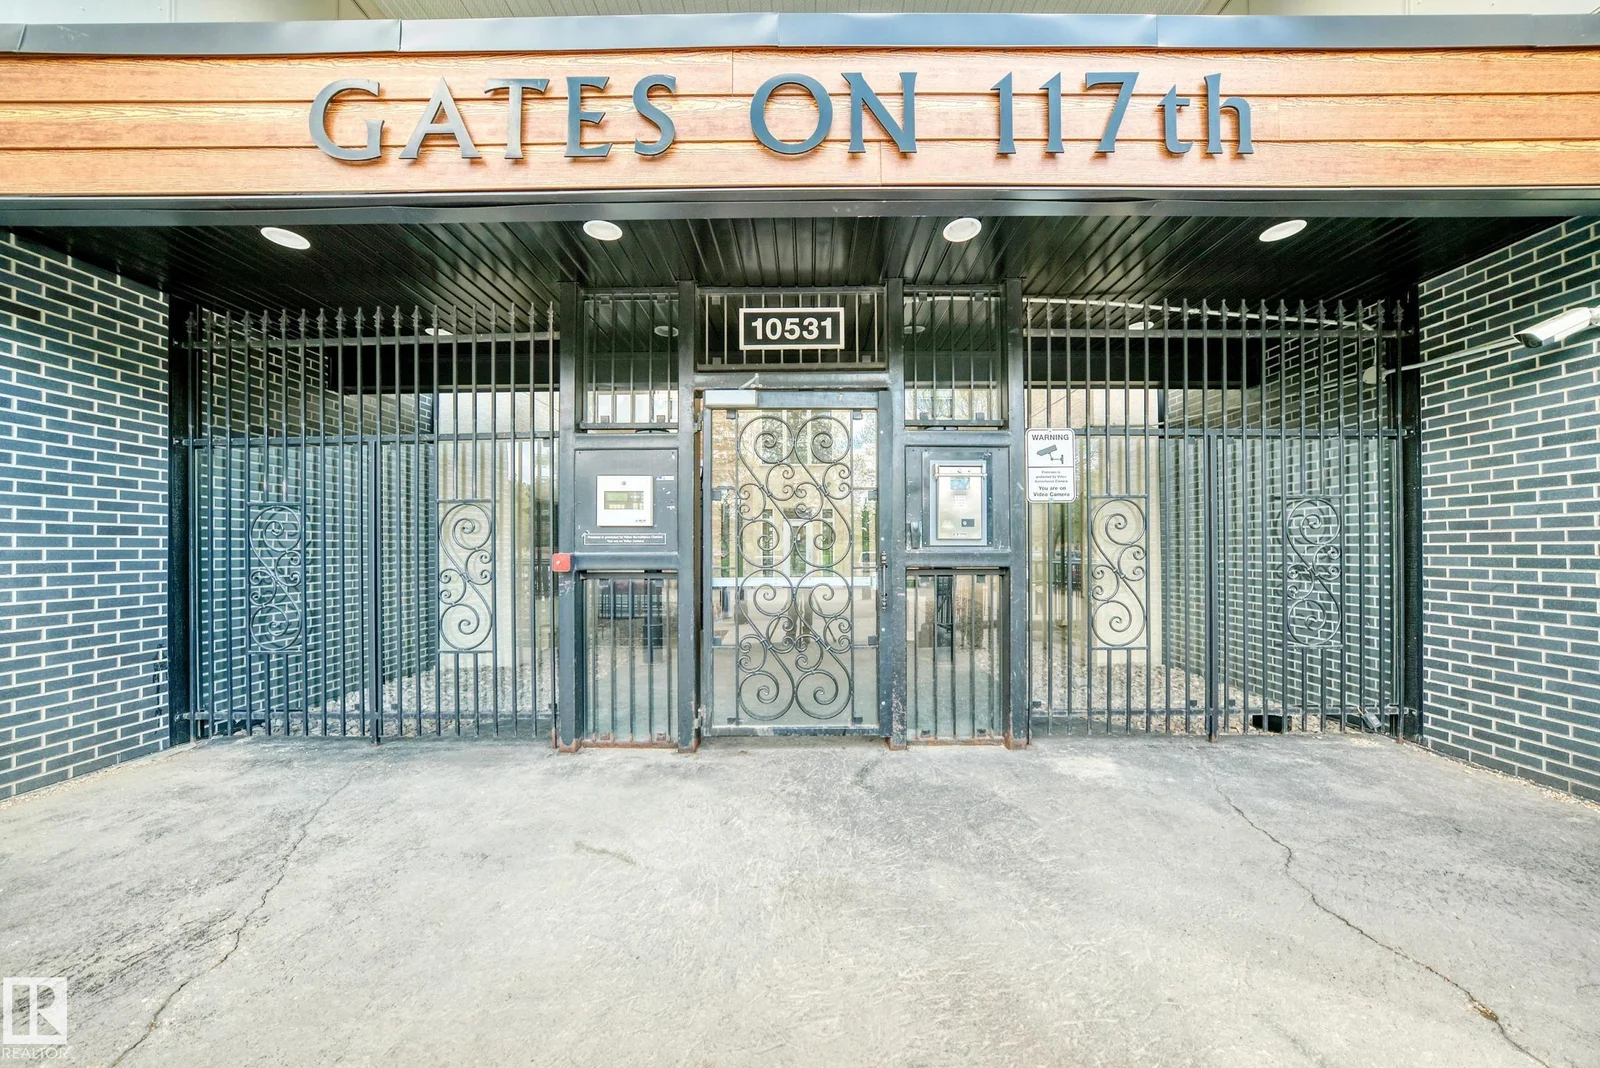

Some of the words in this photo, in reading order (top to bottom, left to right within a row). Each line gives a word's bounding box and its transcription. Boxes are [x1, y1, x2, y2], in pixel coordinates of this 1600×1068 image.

[308, 74, 678, 162] GATES
[750, 70, 918, 156] ON
[990, 71, 1254, 156] 117th
[751, 317, 832, 340] 10531
